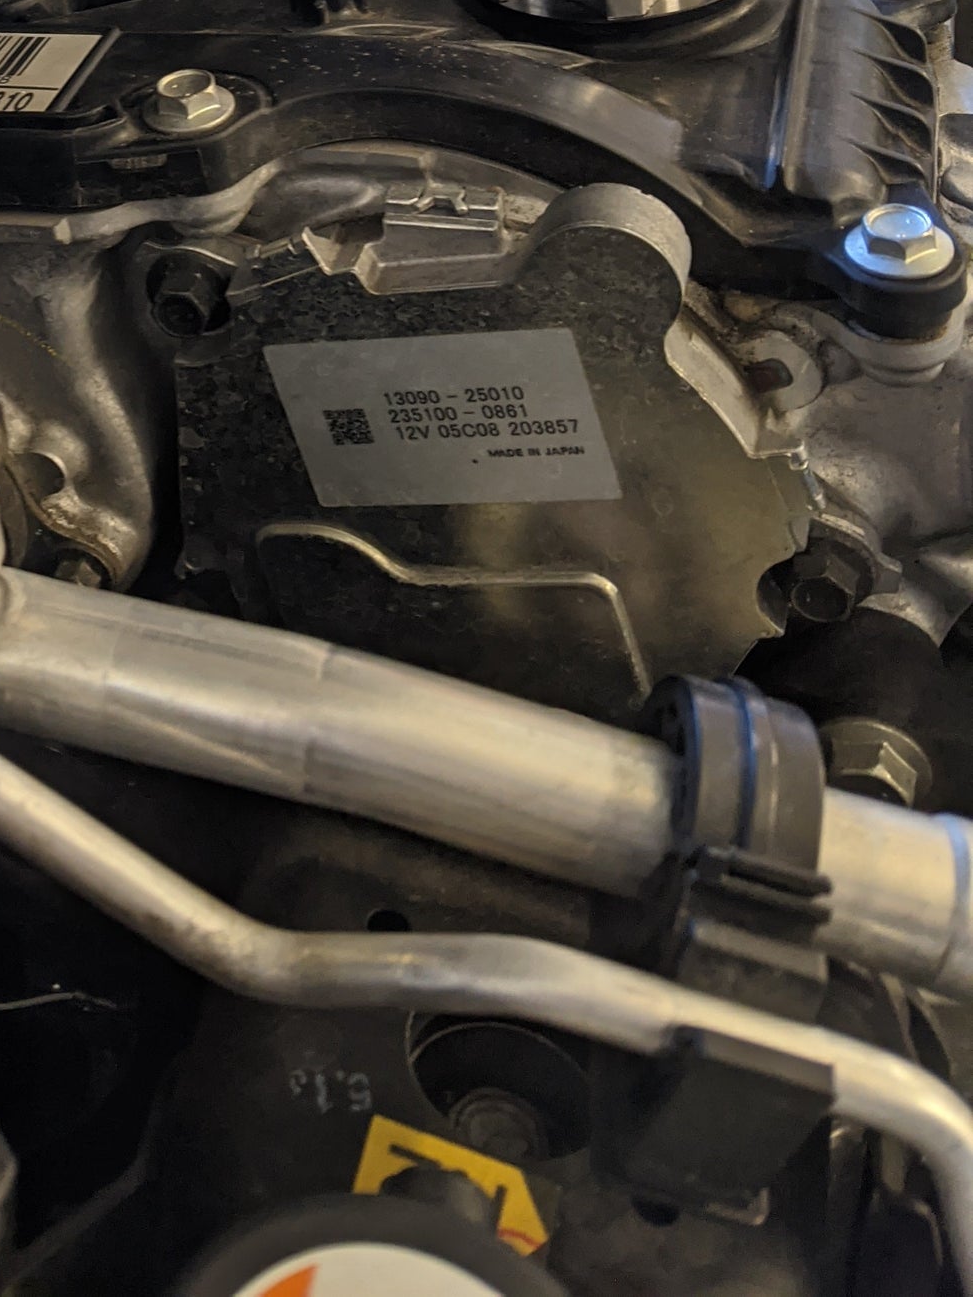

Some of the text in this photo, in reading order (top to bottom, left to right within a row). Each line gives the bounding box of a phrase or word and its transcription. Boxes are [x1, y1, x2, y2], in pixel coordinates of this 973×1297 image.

[383, 389, 440, 406] 13090
[464, 386, 524, 403] 25010
[388, 406, 458, 424] 235100
[481, 404, 528, 420] 0861
[395, 418, 578, 441] 12V 05C08 203857
[486, 446, 585, 458] MADE IN JAPAN
